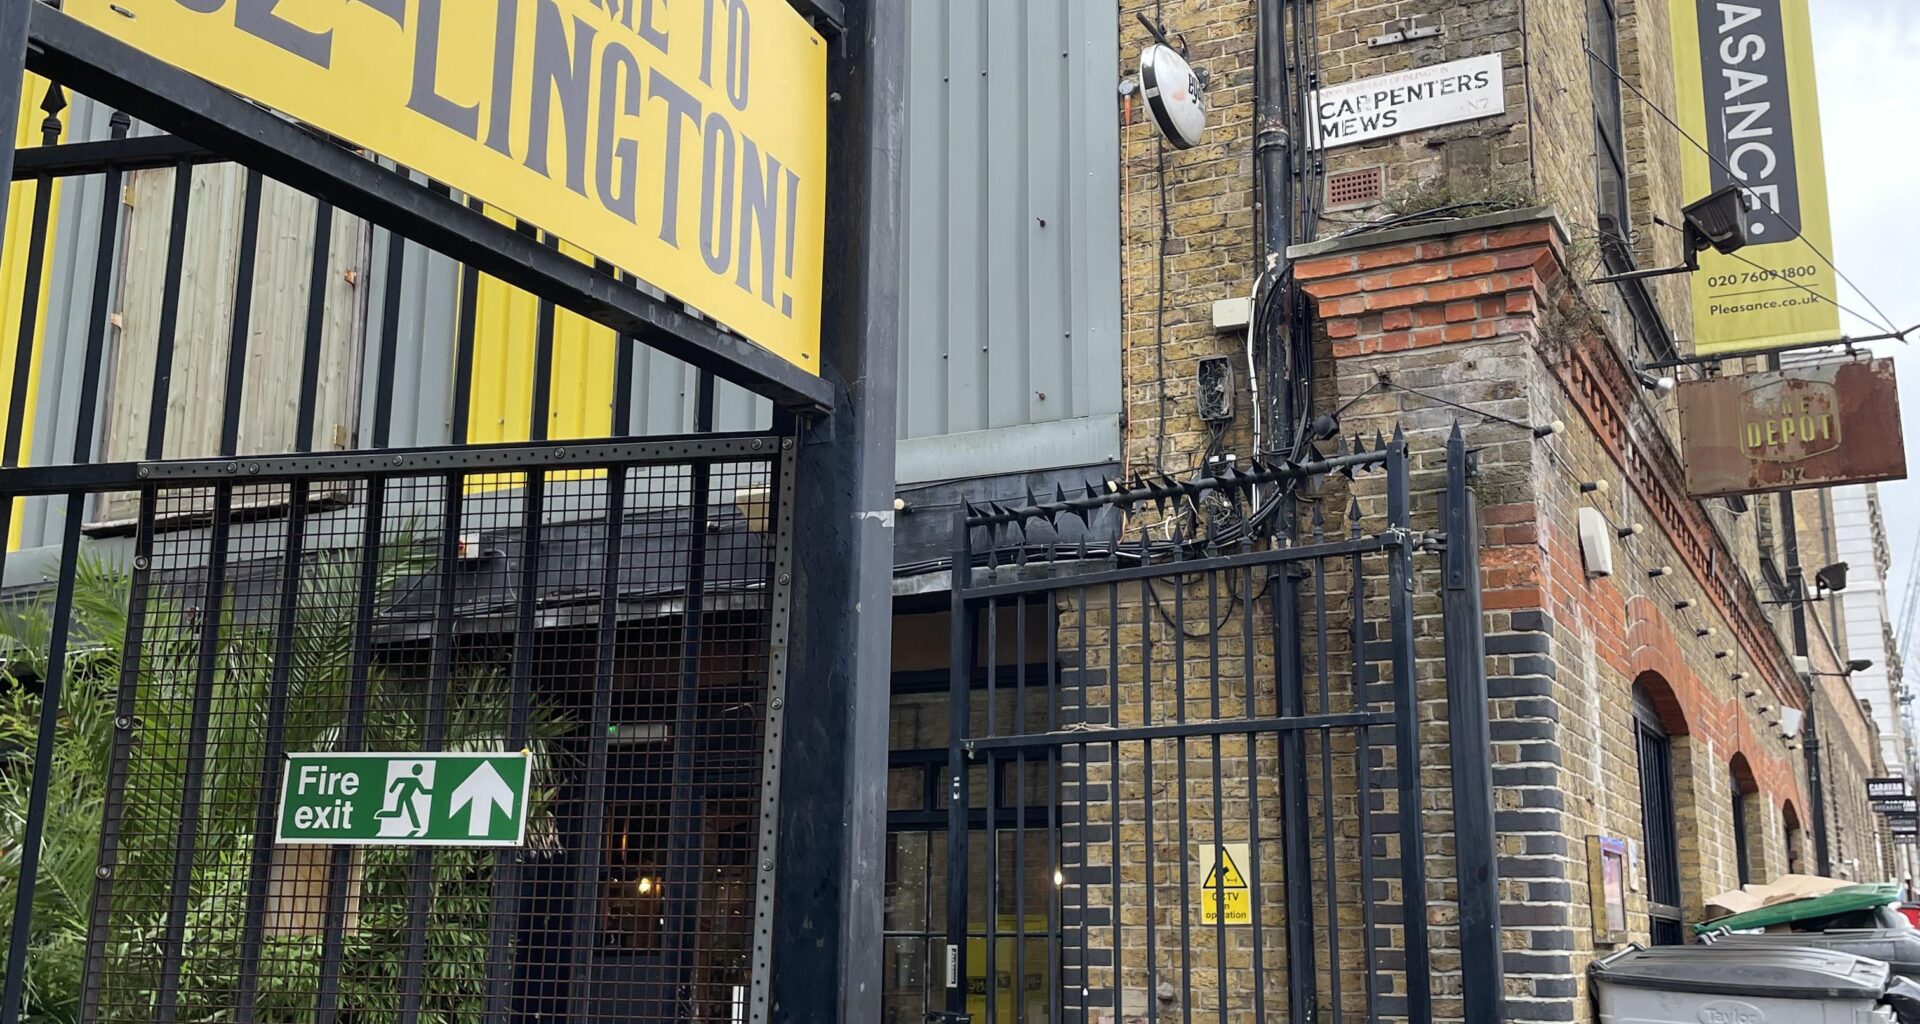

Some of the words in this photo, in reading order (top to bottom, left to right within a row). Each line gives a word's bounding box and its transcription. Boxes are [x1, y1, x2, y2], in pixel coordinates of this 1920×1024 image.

[698, 0, 750, 111] TO
[1320, 70, 1489, 120] CARPENTERS
[1467, 98, 1489, 113] N7
[1322, 109, 1398, 141] MEWS
[1708, 274, 1737, 288] 020
[1741, 270, 1778, 284] 7609
[1781, 265, 1816, 280] 1800
[1710, 292, 1820, 316] Pleasance.co.uk
[1766, 396, 1810, 417] THE
[1747, 414, 1831, 448] DEPOT
[298, 765, 360, 796] Fire
[294, 799, 354, 829] exit
[1206, 911, 1247, 920] opation
